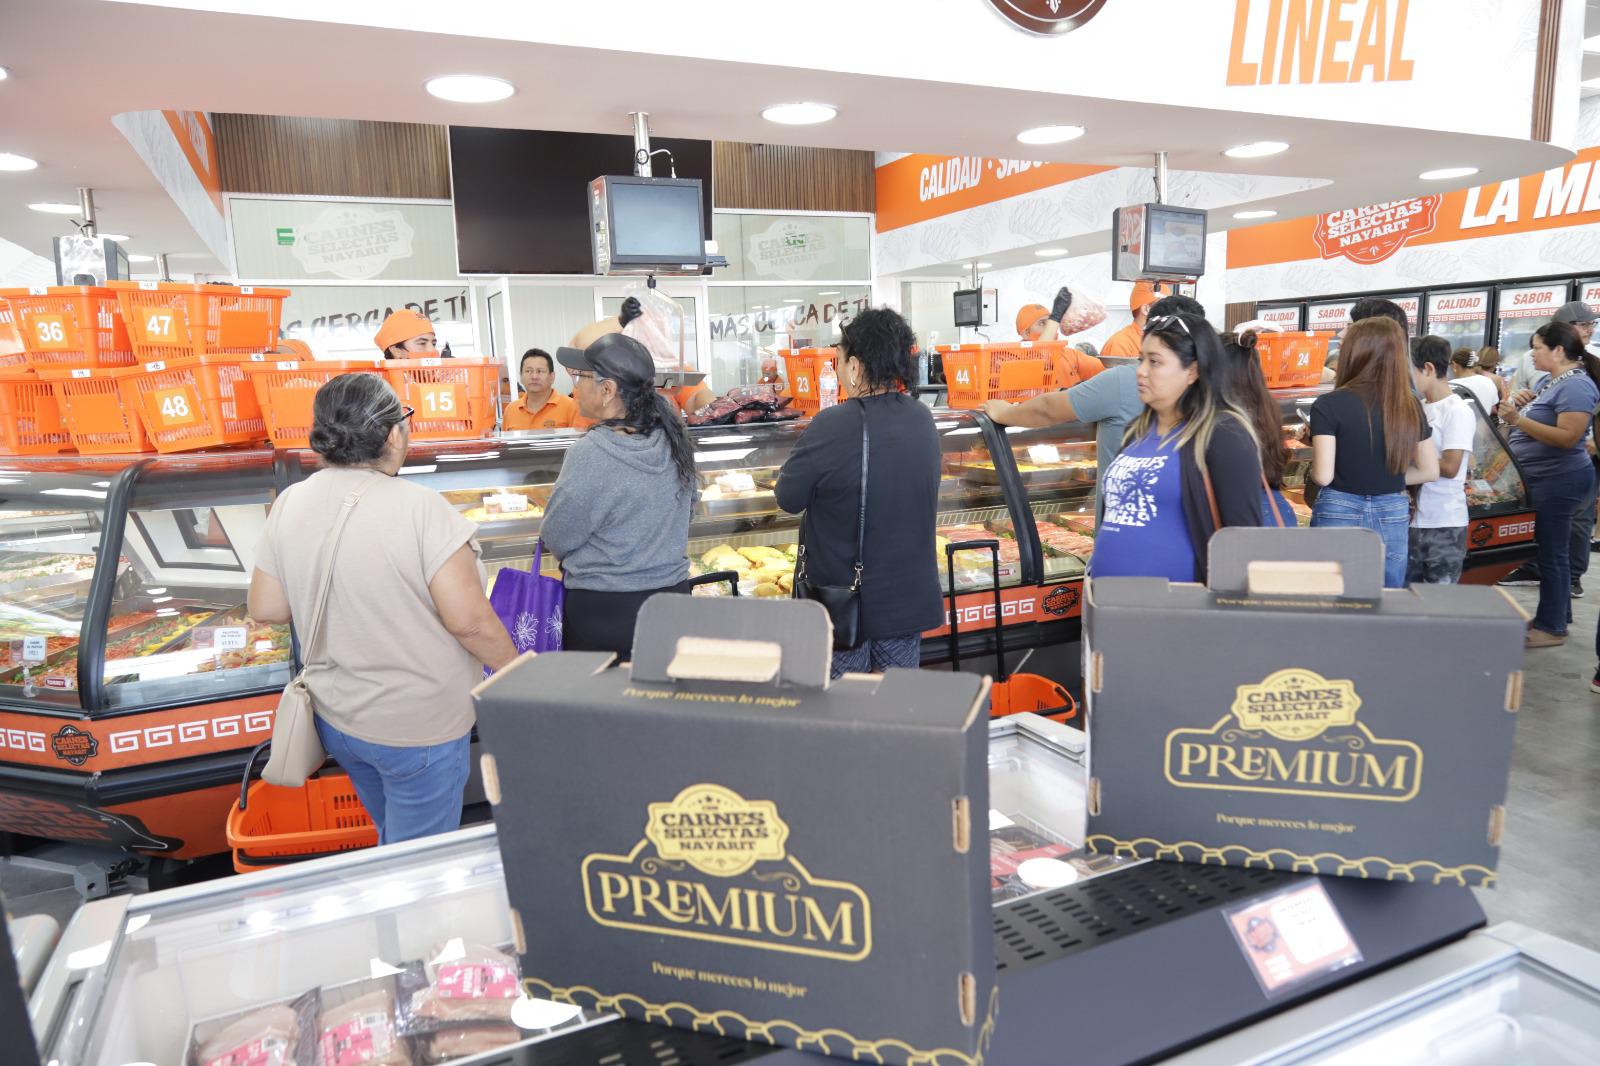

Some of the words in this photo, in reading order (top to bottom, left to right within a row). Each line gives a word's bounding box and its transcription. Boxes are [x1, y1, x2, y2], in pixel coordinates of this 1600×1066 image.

[1226, 0, 1415, 86] LINEAL
[920, 156, 982, 202] CALIDAD
[1460, 177, 1520, 230] LA
[1328, 200, 1424, 239] SELECTAS
[304, 219, 396, 243] CARNES
[1340, 218, 1410, 247] NAYARIT
[308, 231, 400, 256] SELECTAS
[321, 244, 389, 264] NAYARIT
[443, 290, 467, 321] TÍ
[1437, 297, 1480, 310] CALIDAD
[1513, 291, 1553, 305] SABOR
[710, 312, 750, 341] MÁS
[754, 303, 819, 333] CERCA
[823, 300, 849, 324] DE
[1263, 311, 1295, 321] CALIDAD
[1317, 308, 1346, 319] SABOR
[38, 322, 64, 342] 36
[147, 315, 171, 336] 47
[1298, 352, 1310, 367] 24
[797, 376, 809, 393] 23
[956, 369, 970, 385] 44
[161, 395, 189, 418] 48
[424, 391, 453, 412] 15
[1247, 688, 1342, 704] CARNES
[1248, 700, 1343, 714] SELECTAS
[1260, 711, 1331, 722] NAYARIT
[1178, 742, 1409, 791] PREMIUM
[660, 811, 766, 827] CARNES
[1216, 812, 1256, 828] Porque
[1258, 817, 1307, 830] mereces
[1308, 819, 1320, 831] lo
[1321, 822, 1357, 835] mejor
[664, 827, 769, 840] SELECTAS
[679, 840, 757, 851] NAYARIT
[597, 871, 857, 947] PREMIUM
[651, 960, 697, 981] Porque
[698, 970, 753, 989] mereces
[753, 975, 766, 992] lo
[768, 982, 808, 999] mejor
